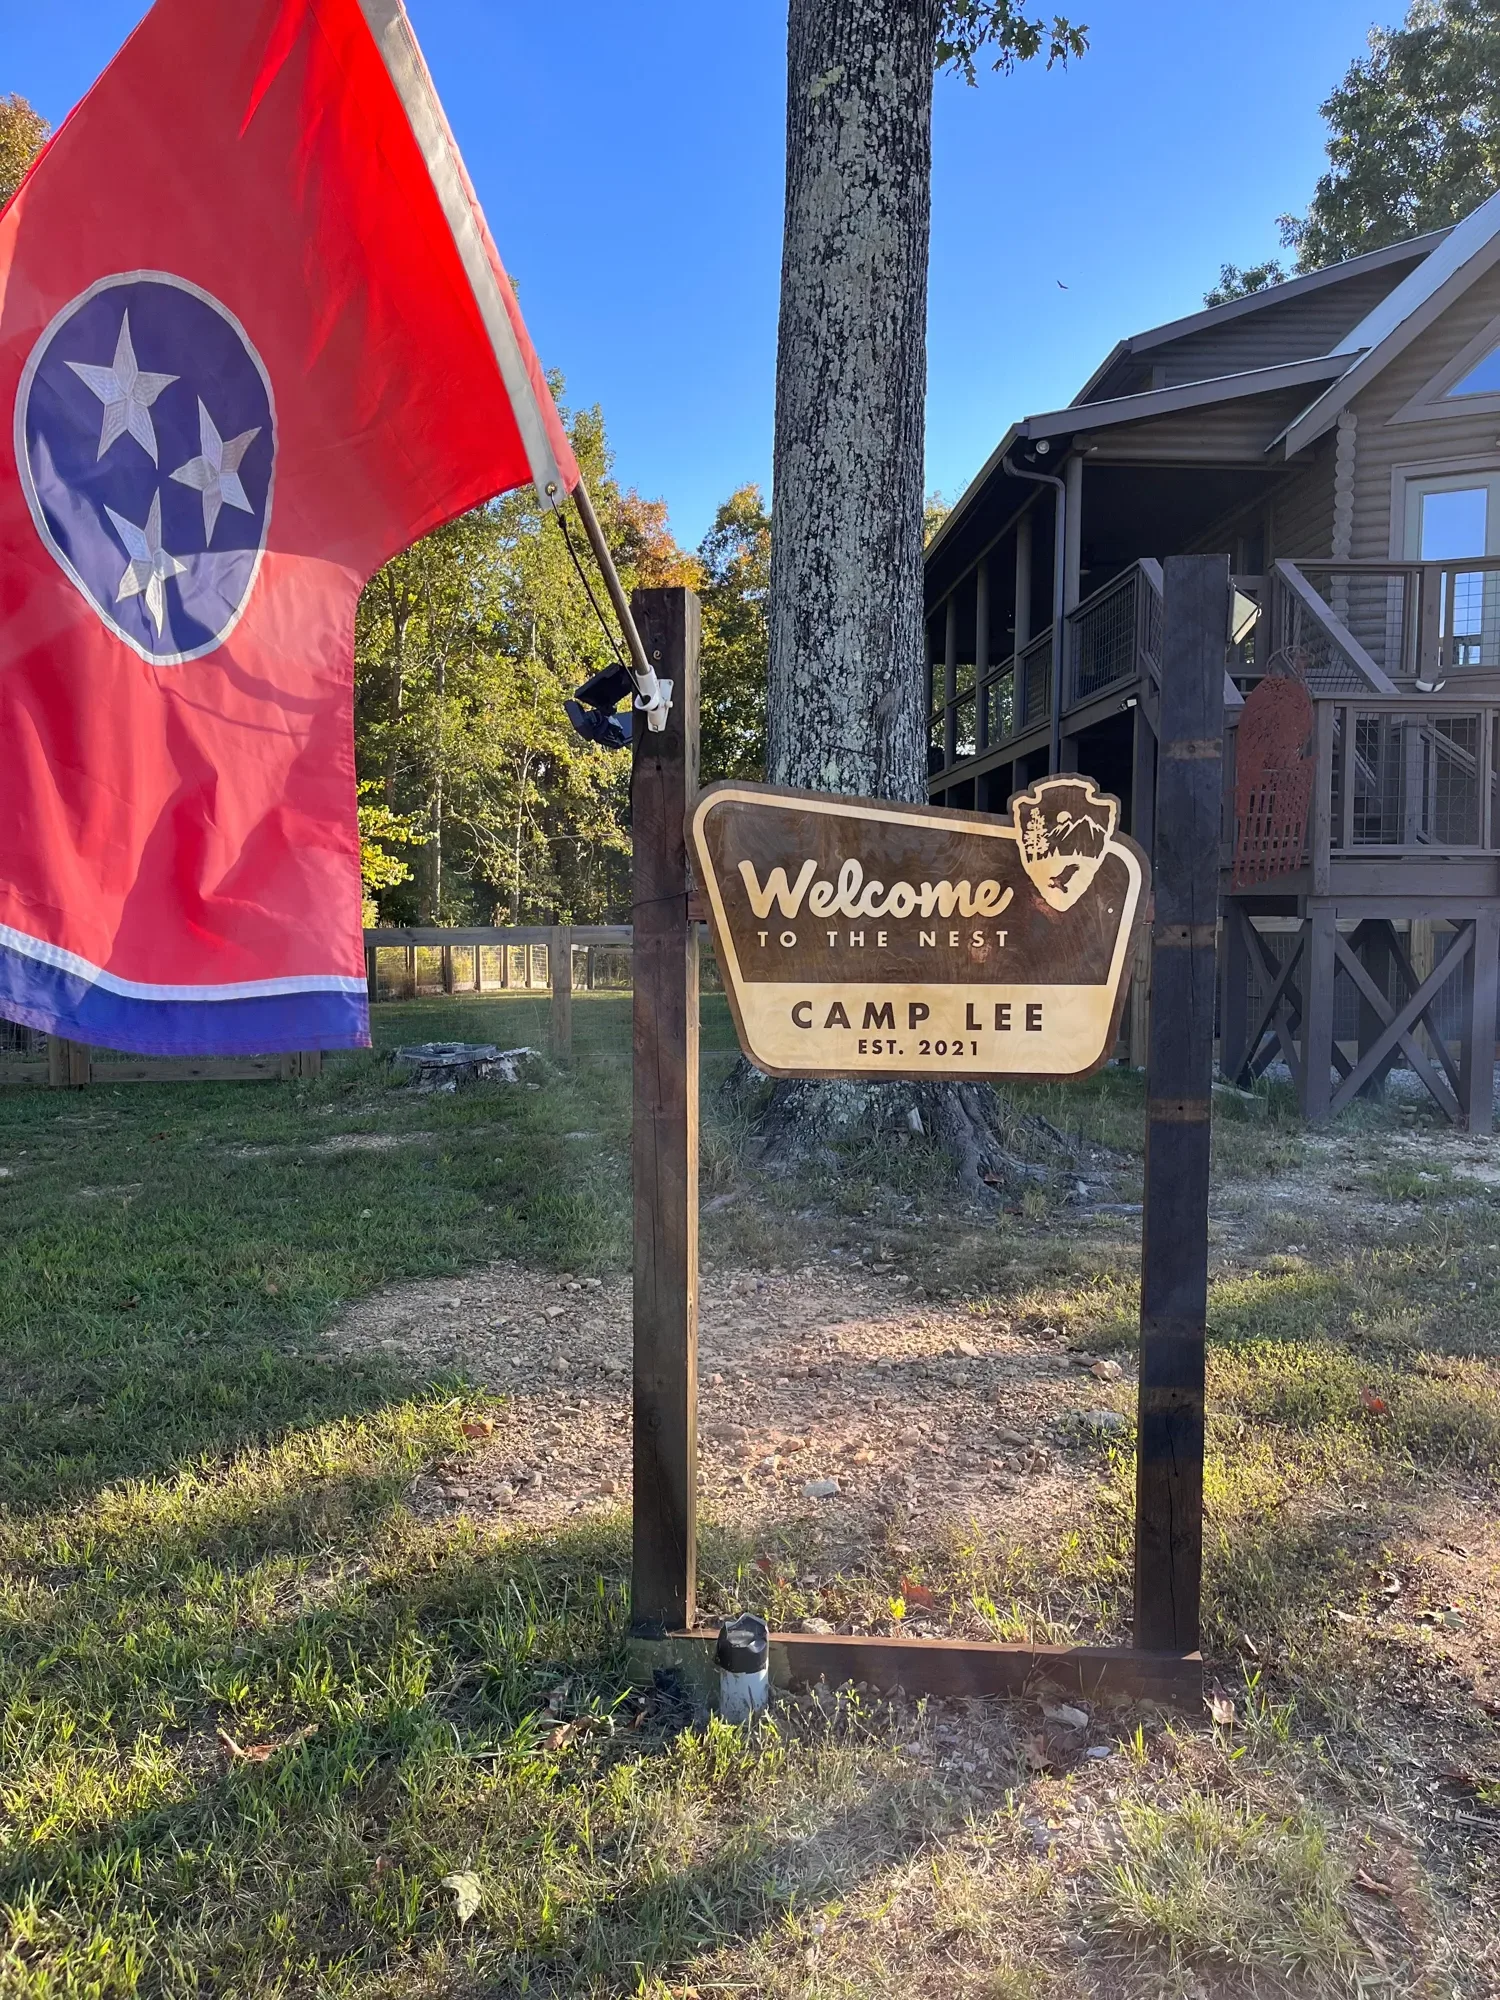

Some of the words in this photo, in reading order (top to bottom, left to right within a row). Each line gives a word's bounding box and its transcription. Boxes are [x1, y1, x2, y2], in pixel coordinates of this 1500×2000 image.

[737, 858, 1014, 919] Welcome
[757, 931, 798, 948] TO
[826, 931, 888, 947] THE
[919, 930, 1009, 947] NEST
[791, 1000, 931, 1030] CAMP
[965, 1002, 1044, 1031] LEE
[857, 1039, 904, 1055] EST.
[918, 1040, 979, 1056] 2021
